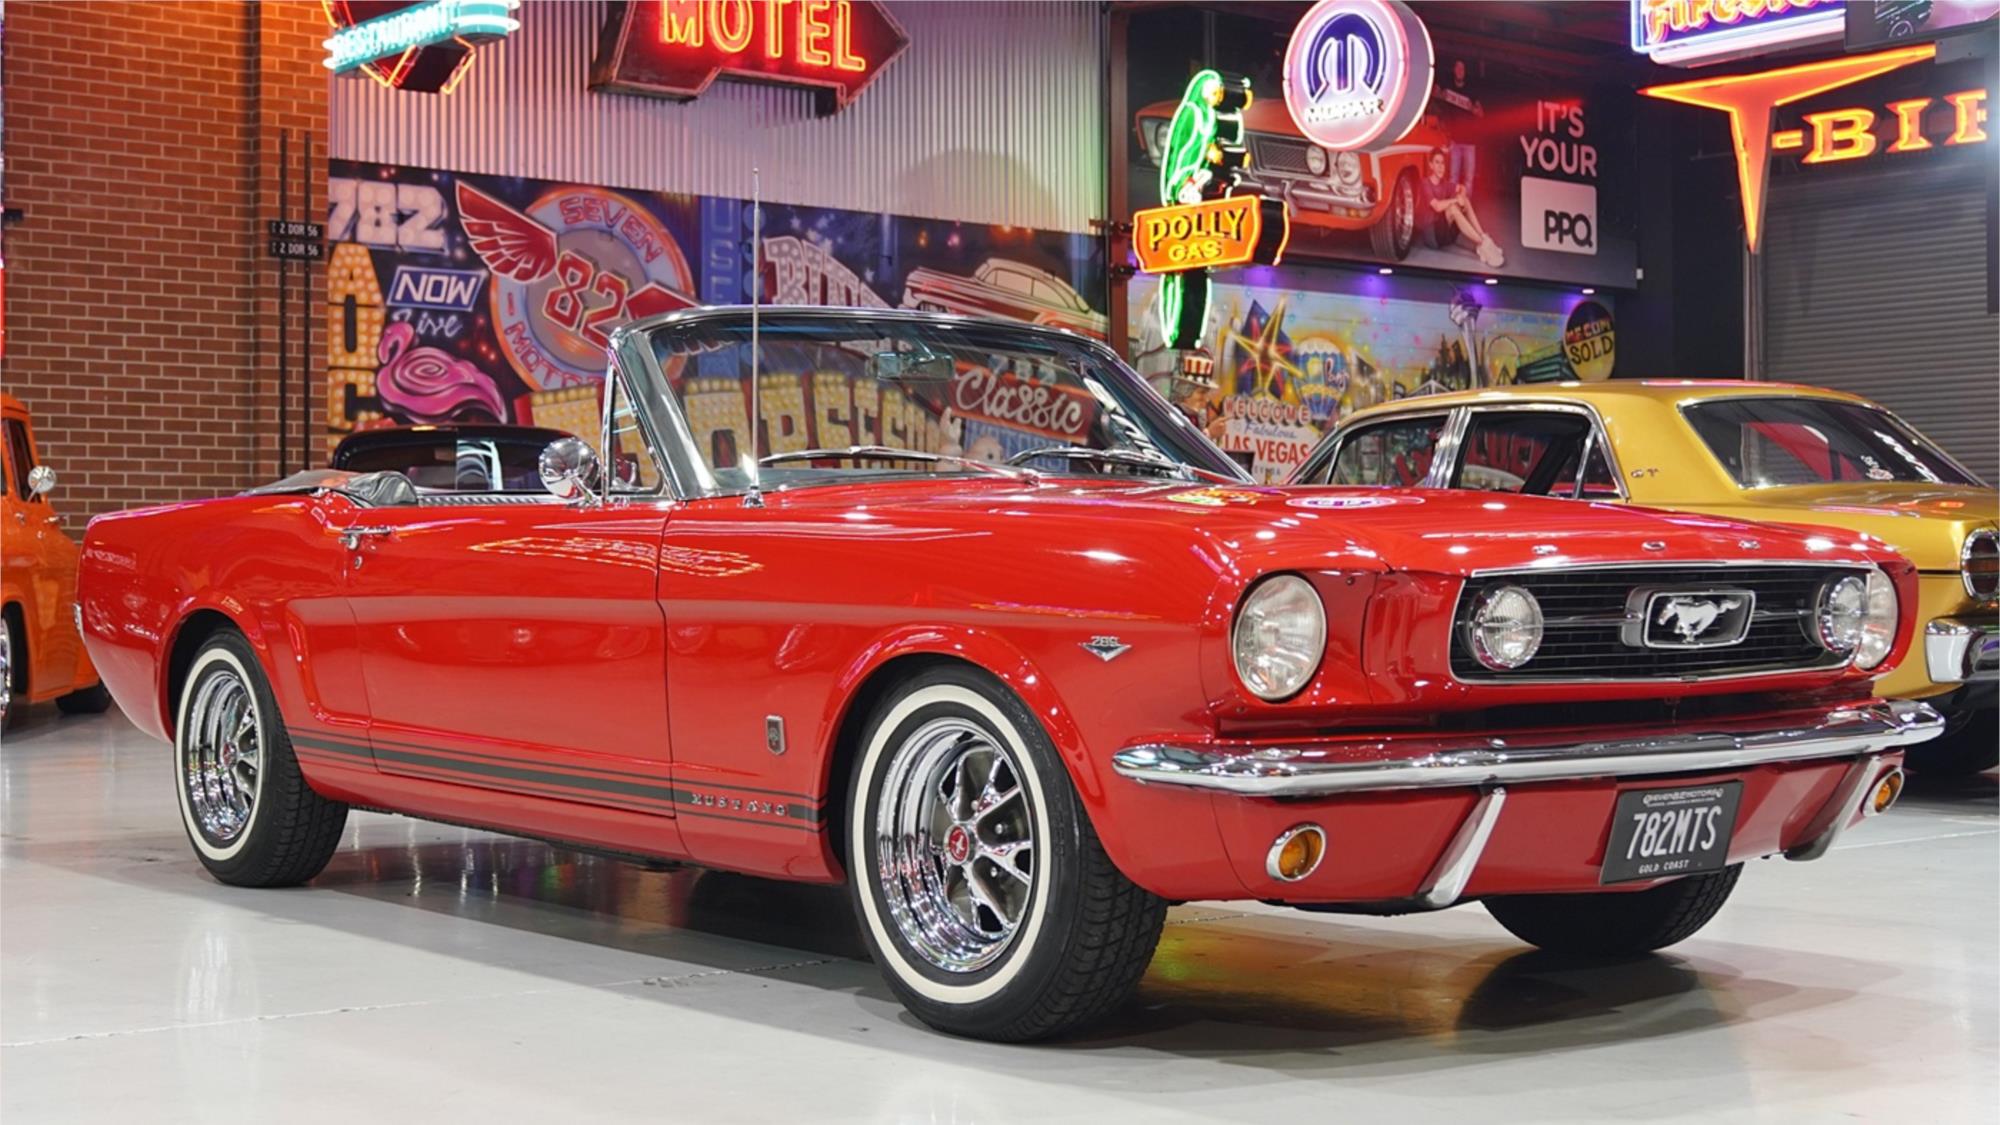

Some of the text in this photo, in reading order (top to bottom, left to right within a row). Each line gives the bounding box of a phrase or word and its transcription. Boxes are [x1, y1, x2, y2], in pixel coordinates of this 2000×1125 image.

[660, 0, 866, 71] MOTEL
[1537, 100, 1584, 138] IT'S
[1520, 135, 1597, 177] YOUR
[328, 177, 448, 252] 782
[559, 196, 663, 263] SEVEN
[1147, 207, 1247, 251] POLLY
[1544, 209, 1593, 248] PPQ
[1168, 239, 1222, 262] GAS
[395, 272, 476, 306] NOW
[542, 250, 629, 351] 82
[1569, 335, 1613, 365] SOLD
[954, 366, 1085, 433] Classic
[1224, 398, 1311, 424] WELCOME
[1224, 433, 1310, 465] LAS VEGAS
[691, 794, 785, 816] MUSTANG
[1626, 805, 1722, 859] 782MTS
[1638, 859, 1690, 875] GOLD COAST
